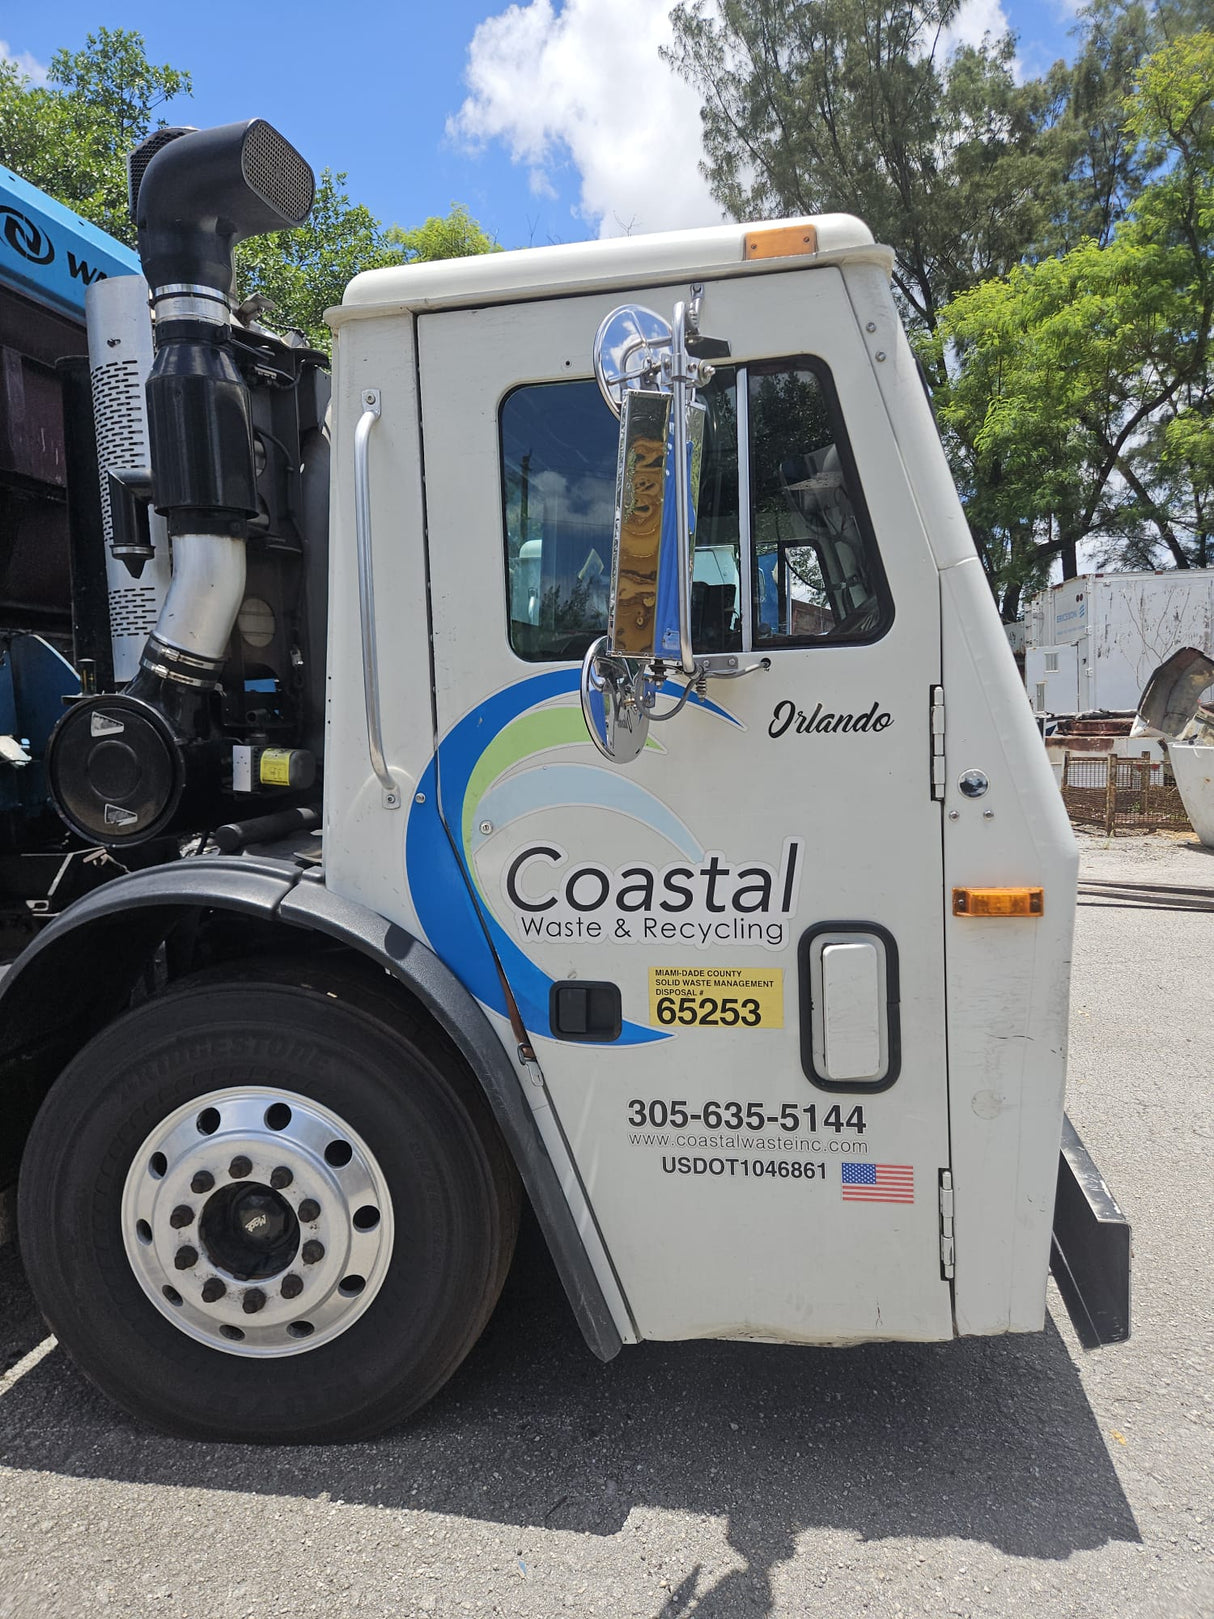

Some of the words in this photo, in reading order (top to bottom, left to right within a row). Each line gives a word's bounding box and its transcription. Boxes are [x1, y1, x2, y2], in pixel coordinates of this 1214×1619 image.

[768, 699, 894, 739] Orlando
[506, 842, 799, 913] Coastal
[521, 917, 601, 938] Waste
[614, 918, 632, 938] &
[644, 917, 783, 945] Recycling
[655, 969, 705, 977] MIAMI-DADE
[707, 970, 742, 978] COUNTY
[682, 979, 711, 987] WASTE
[713, 980, 774, 988] MANAGEMENT
[655, 988, 697, 996] DISPOSAL
[656, 996, 762, 1027] 65253
[628, 1099, 867, 1134] 305-635-5144
[628, 1132, 869, 1154] www.coastalwasteinc.com
[662, 1156, 827, 1179] USDOT1046861
